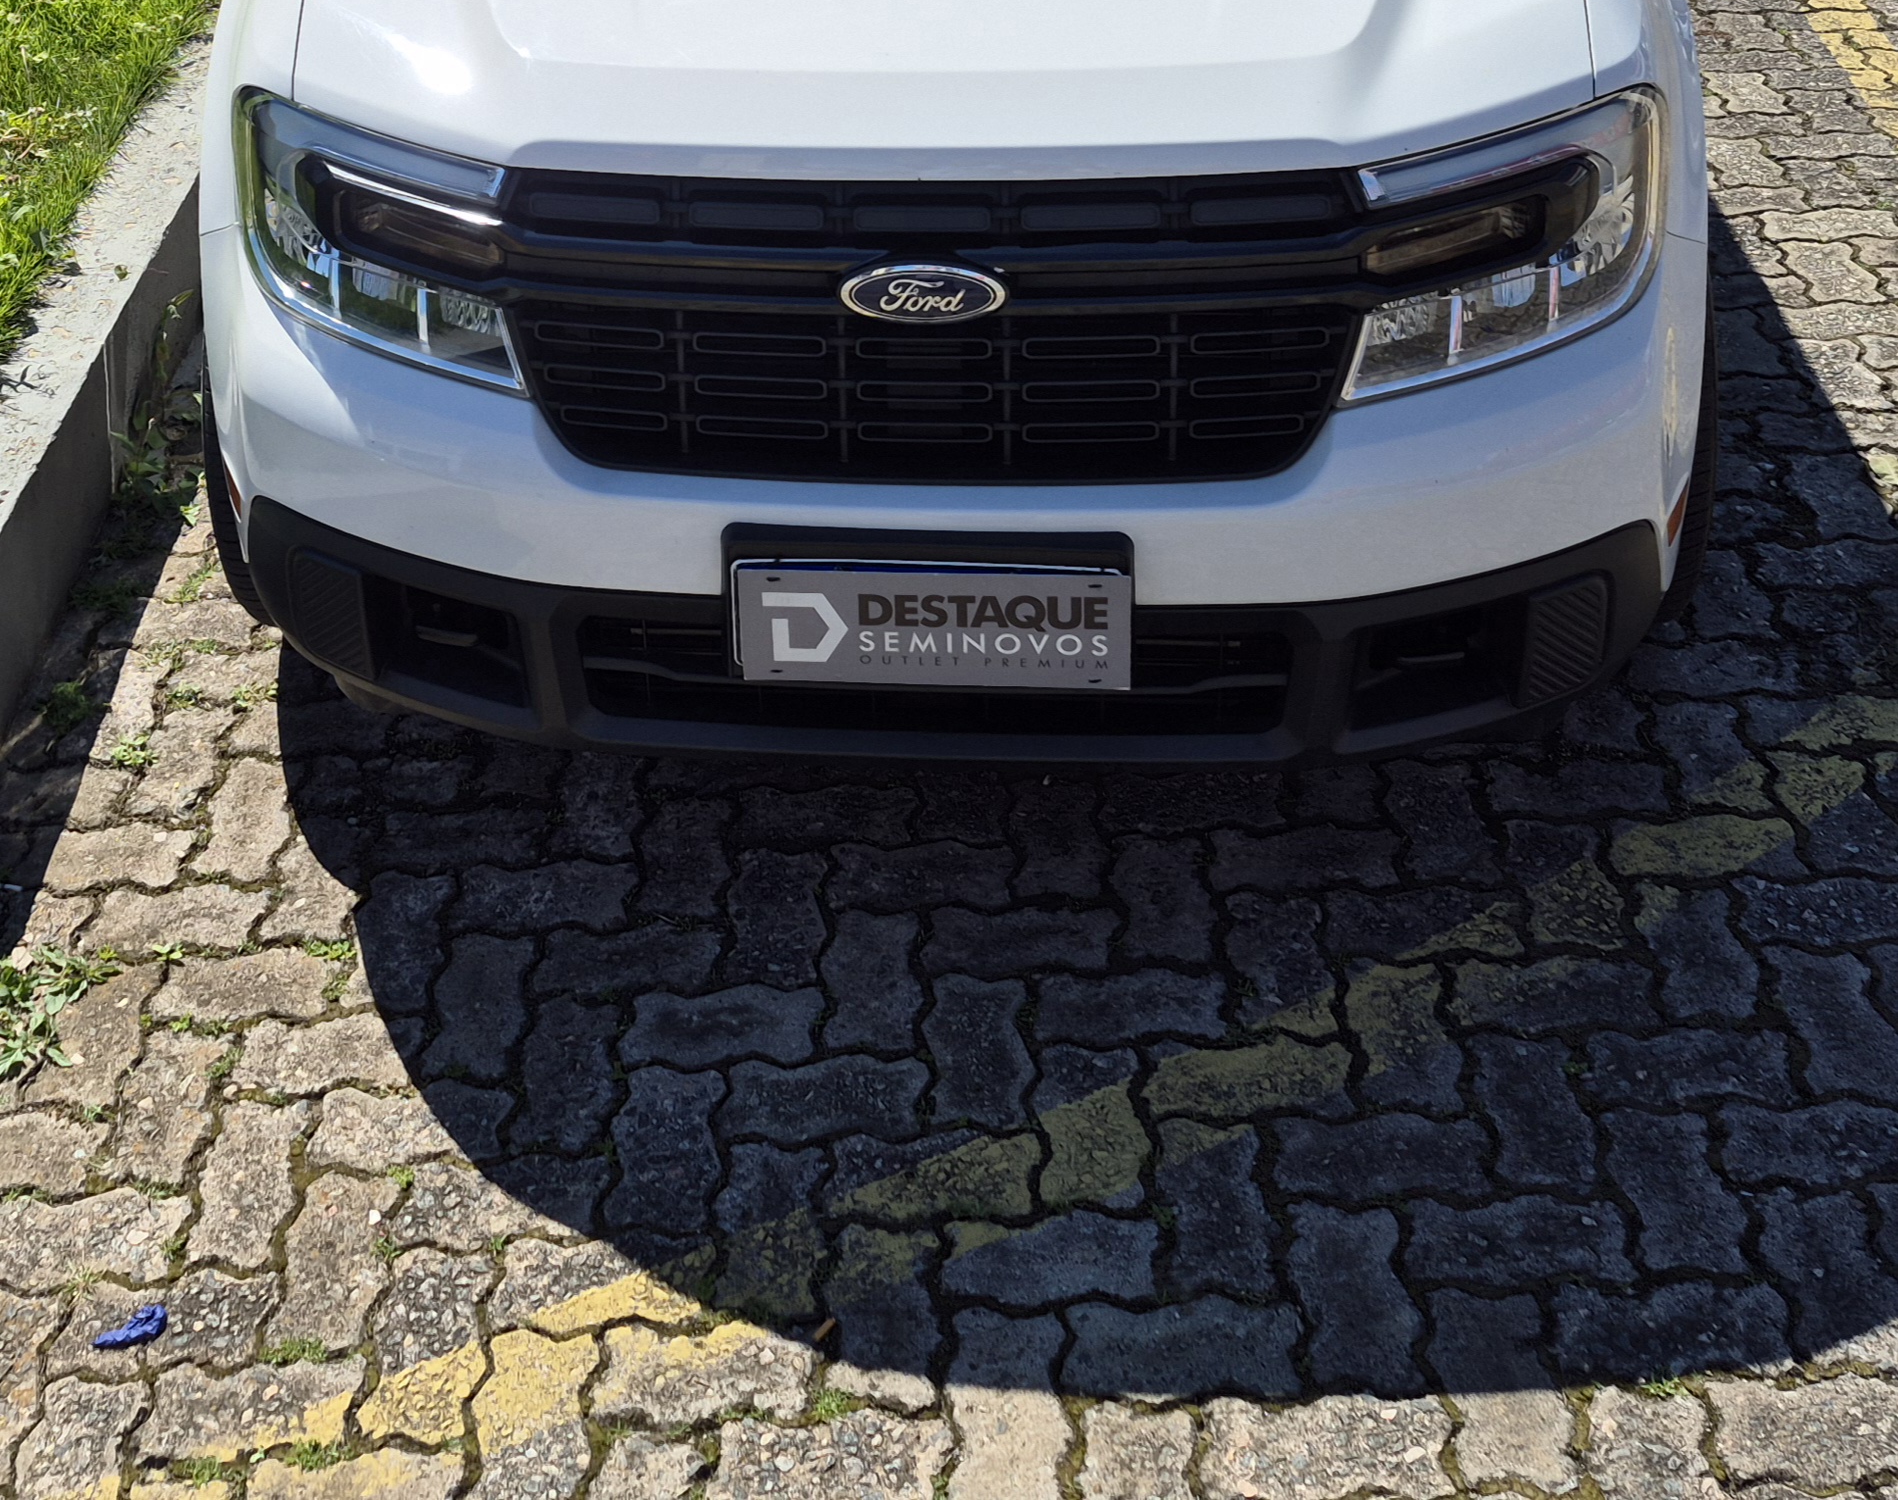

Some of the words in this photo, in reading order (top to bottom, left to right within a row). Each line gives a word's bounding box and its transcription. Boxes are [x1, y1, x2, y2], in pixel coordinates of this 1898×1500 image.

[879, 278, 965, 313] Ford
[857, 593, 1109, 633] DESTAQUE
[857, 630, 1109, 657] SEMINOVOS
[858, 654, 960, 667] OUTLET
[984, 656, 1109, 670] PREMIUM
